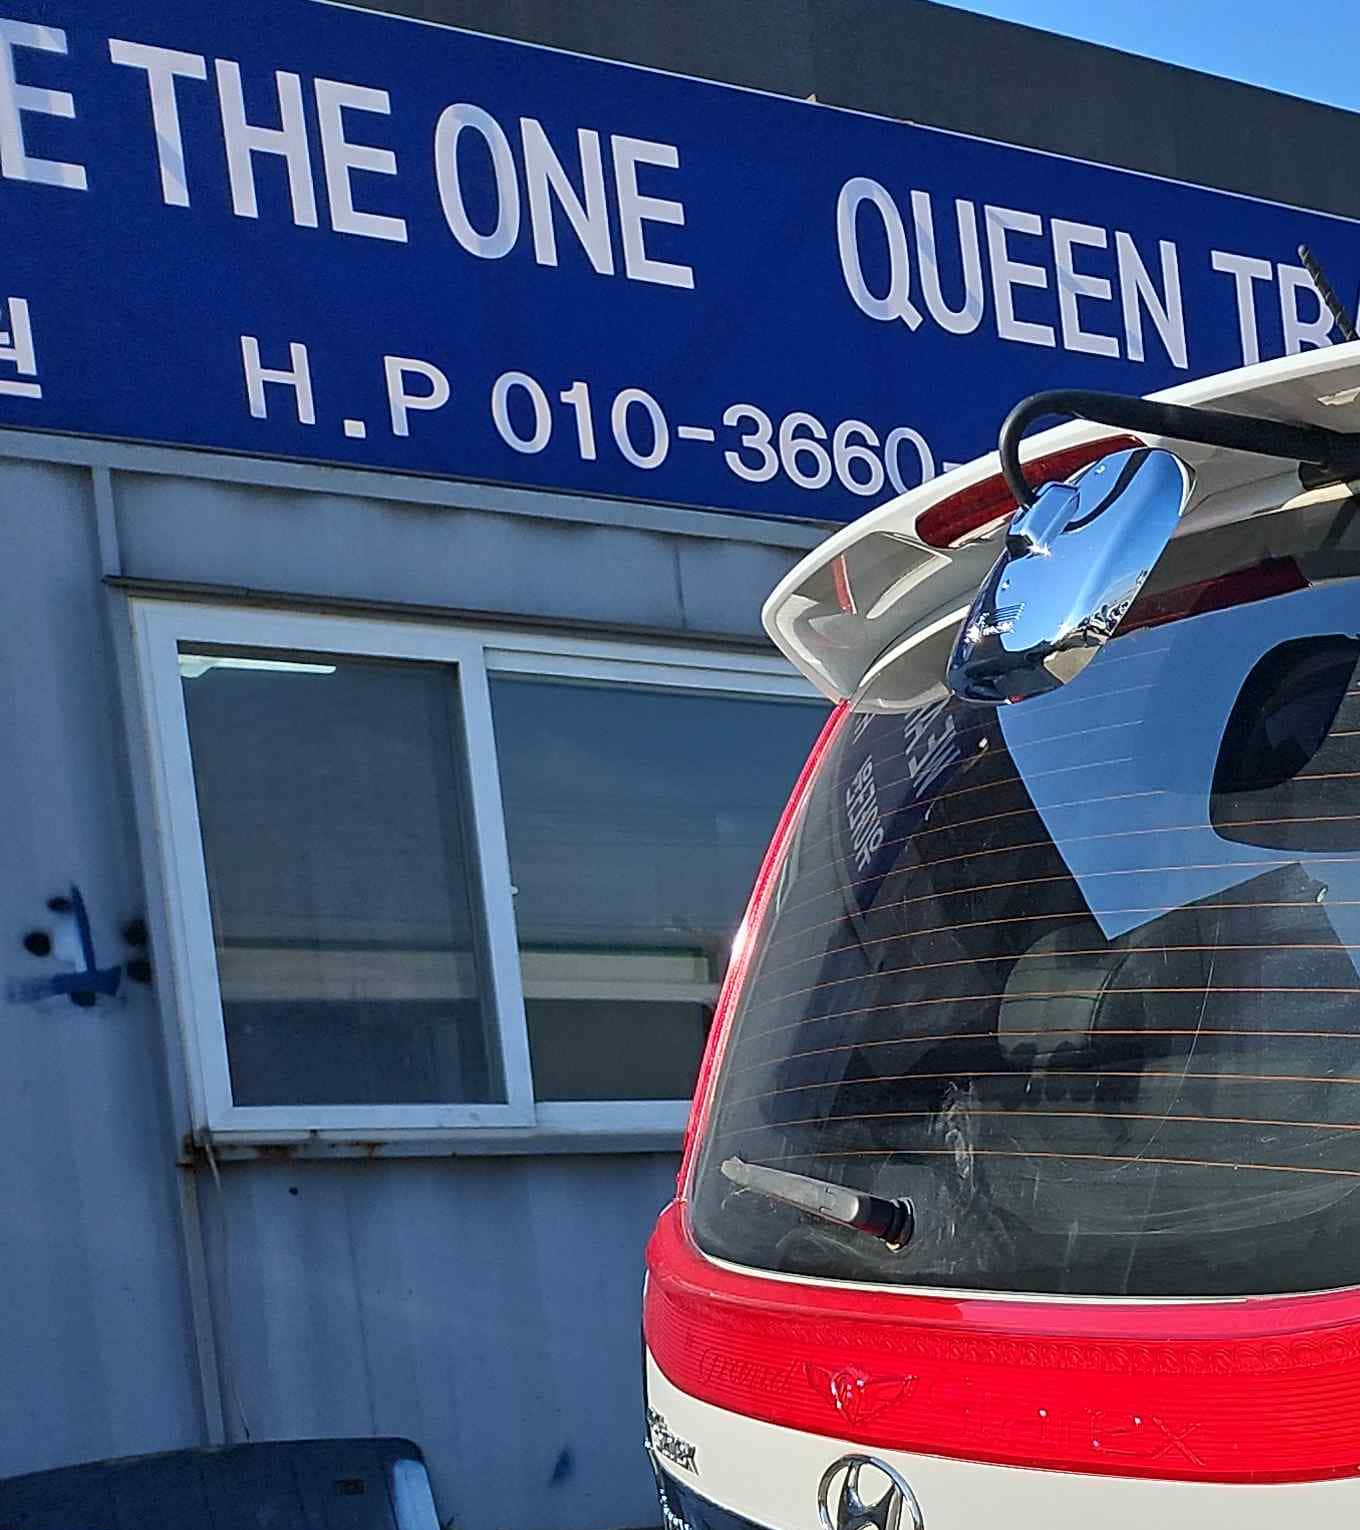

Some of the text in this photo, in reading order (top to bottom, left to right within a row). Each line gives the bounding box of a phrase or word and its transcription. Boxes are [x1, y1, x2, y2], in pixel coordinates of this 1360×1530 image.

[108, 38, 408, 243] THE
[434, 103, 695, 289] ONE
[837, 177, 1188, 369] QUEEN
